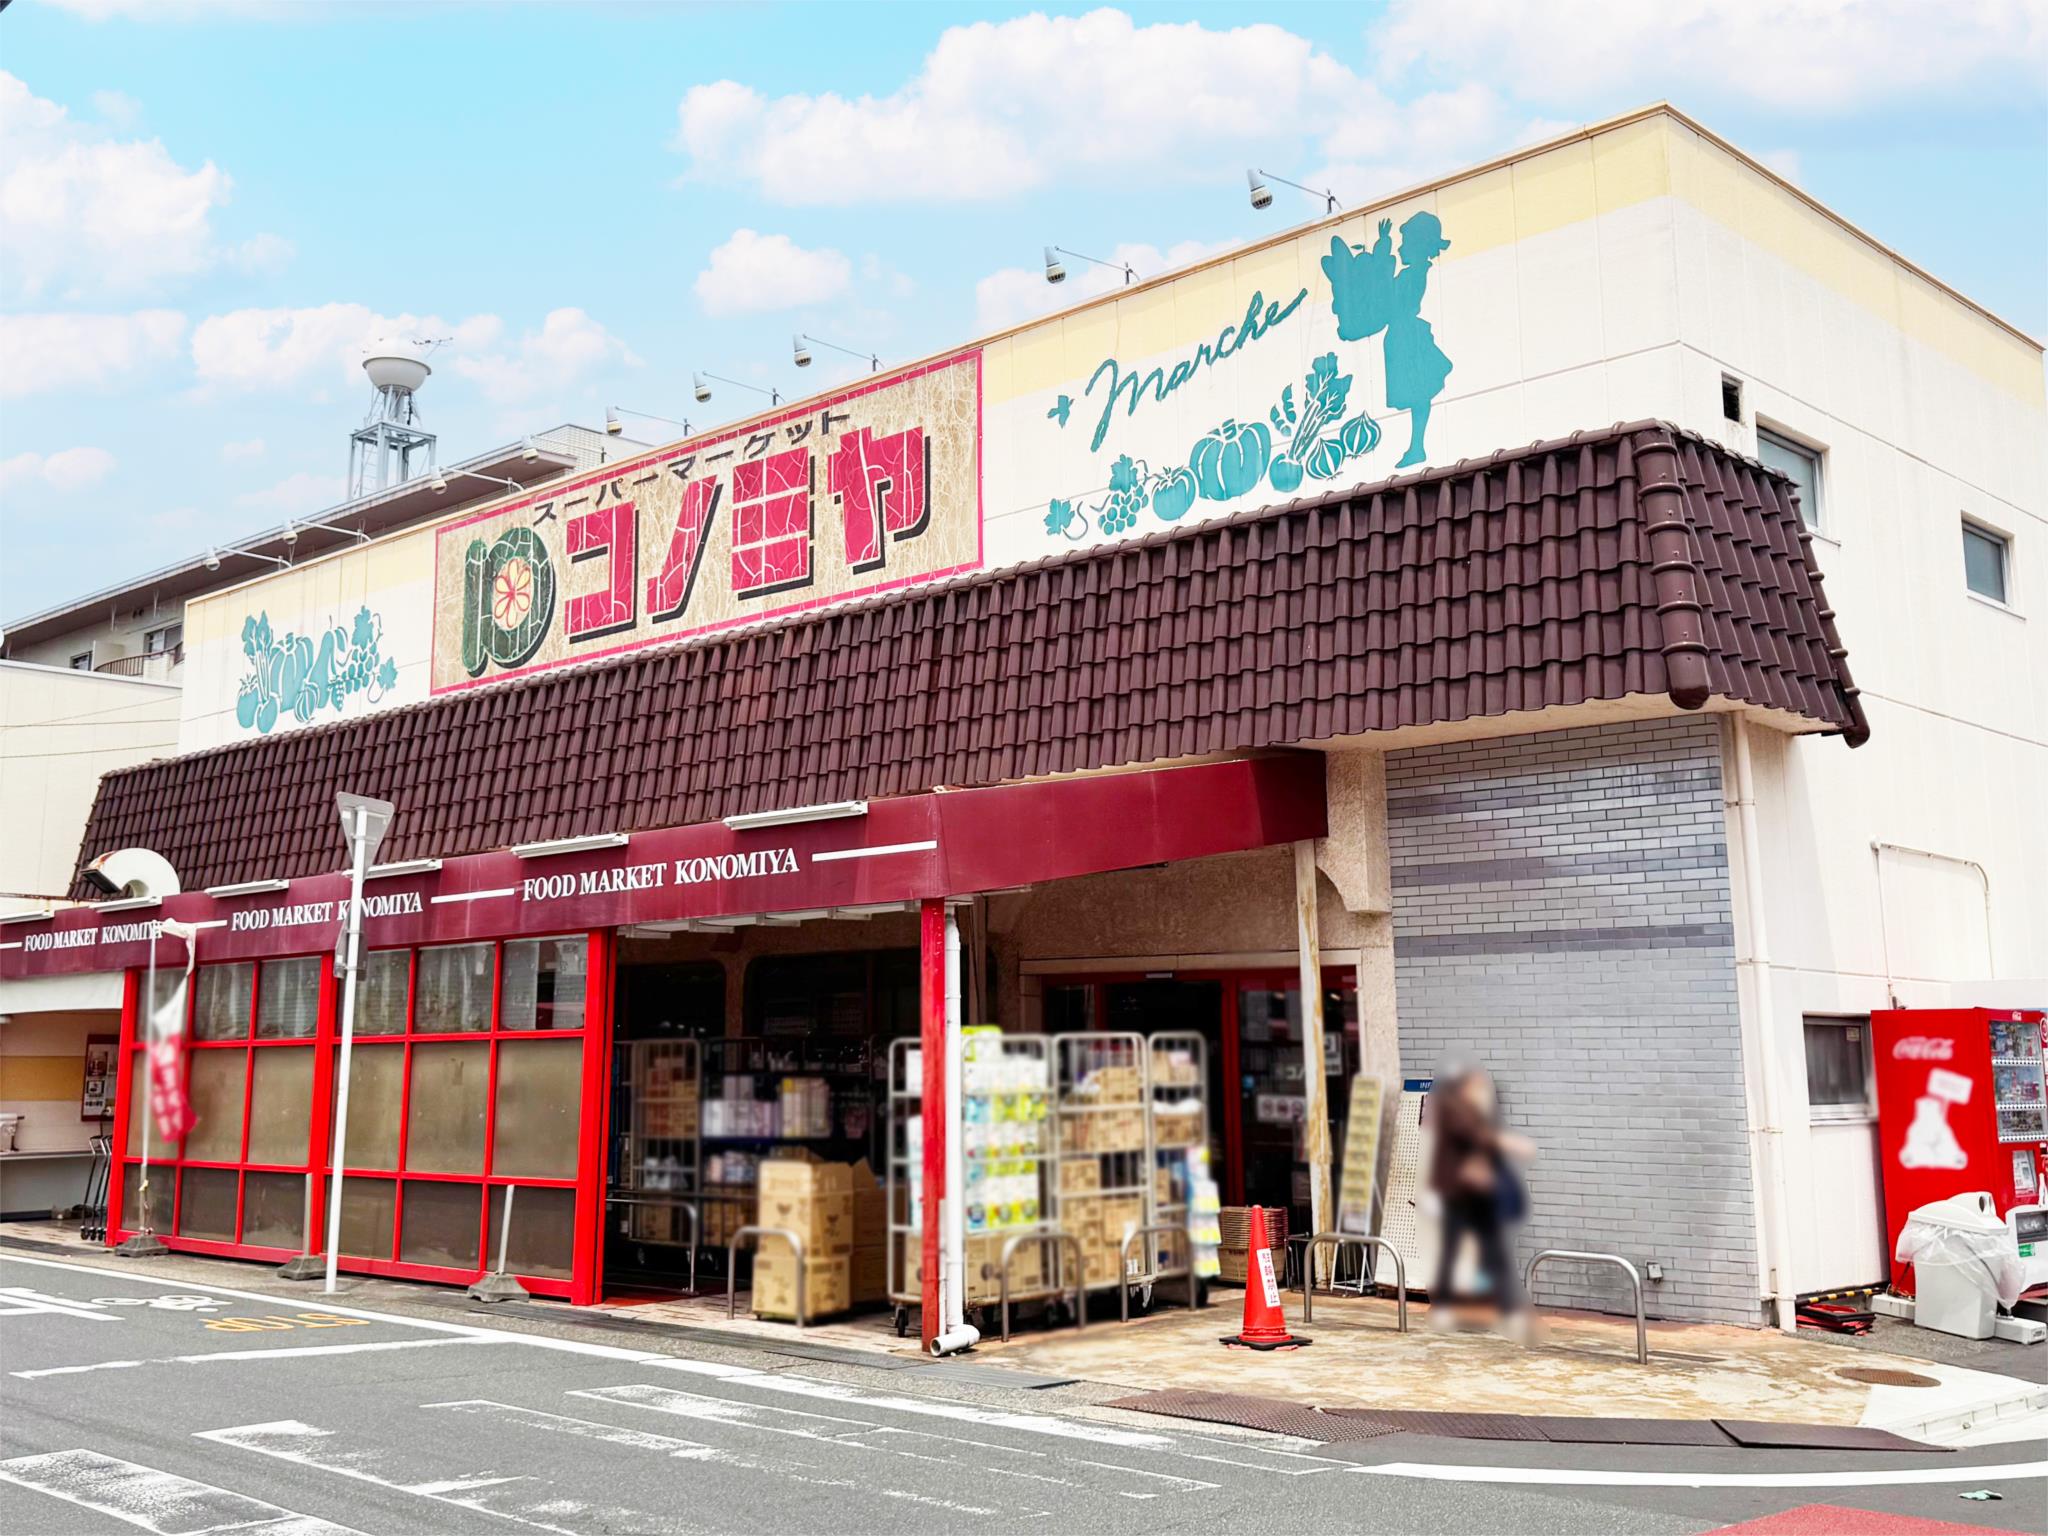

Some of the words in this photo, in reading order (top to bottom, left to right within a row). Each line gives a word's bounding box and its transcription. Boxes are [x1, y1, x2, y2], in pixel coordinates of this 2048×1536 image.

[533, 411, 850, 526] スーパーマーケット
[565, 427, 931, 645] コノミヤ
[523, 874, 576, 901] FOOD
[579, 863, 667, 896] MARKET
[674, 847, 800, 885] KONOMIYA
[231, 910, 270, 931] FOOD
[271, 902, 333, 927] MARKET
[337, 892, 423, 920] KNOMIYA
[24, 933, 53, 952] FOOD
[54, 928, 98, 948] MARKET
[198, 1312, 370, 1332] STOP
